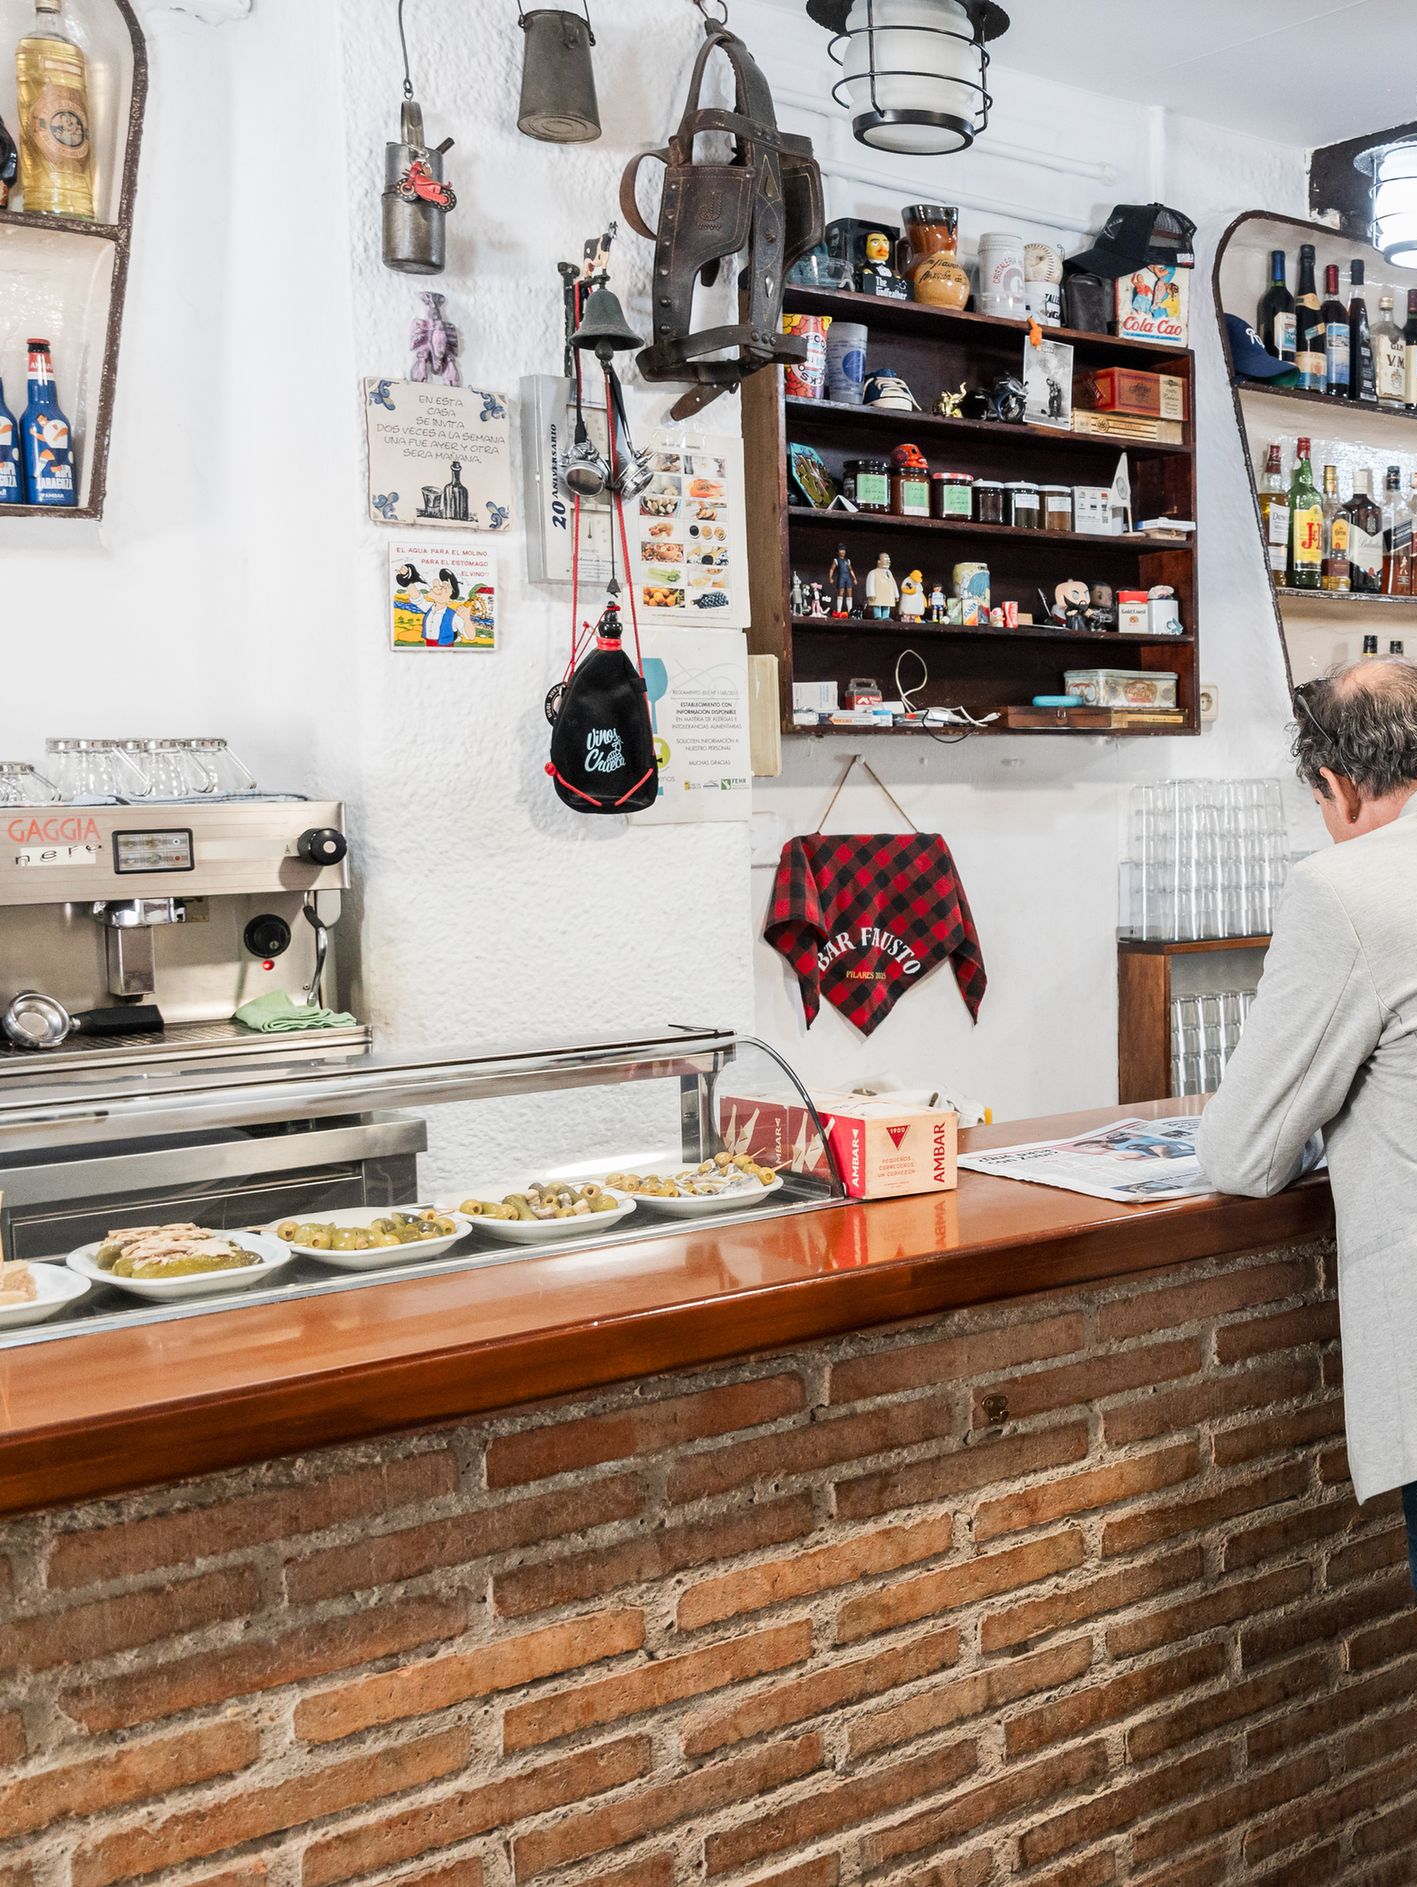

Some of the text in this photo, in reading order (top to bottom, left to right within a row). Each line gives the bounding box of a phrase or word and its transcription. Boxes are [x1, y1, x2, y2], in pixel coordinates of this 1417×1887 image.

[875, 275, 887, 287] The
[1122, 315, 1154, 333] Cola
[1157, 319, 1182, 336] Cao
[419, 395, 463, 407] EN ESTA
[416, 417, 430, 426] SE
[427, 407, 456, 417] CASA
[377, 423, 505, 444] DOS VECES A LA SEMANA
[384, 436, 500, 455] UNA FUE AYER Y OTRA
[403, 448, 433, 459] SERA
[550, 423, 567, 530] 20 ANIVERSARIO
[586, 727, 619, 750] Vinos
[7, 816, 101, 844] GAGGIA
[817, 927, 921, 974] BAR FAUSTO
[846, 970, 875, 980] PILARES
[890, 1127, 906, 1135] 1900
[774, 1126, 782, 1165] MBAR
[931, 1120, 946, 1183] AMBAR
[852, 1138, 860, 1188] AMBAR
